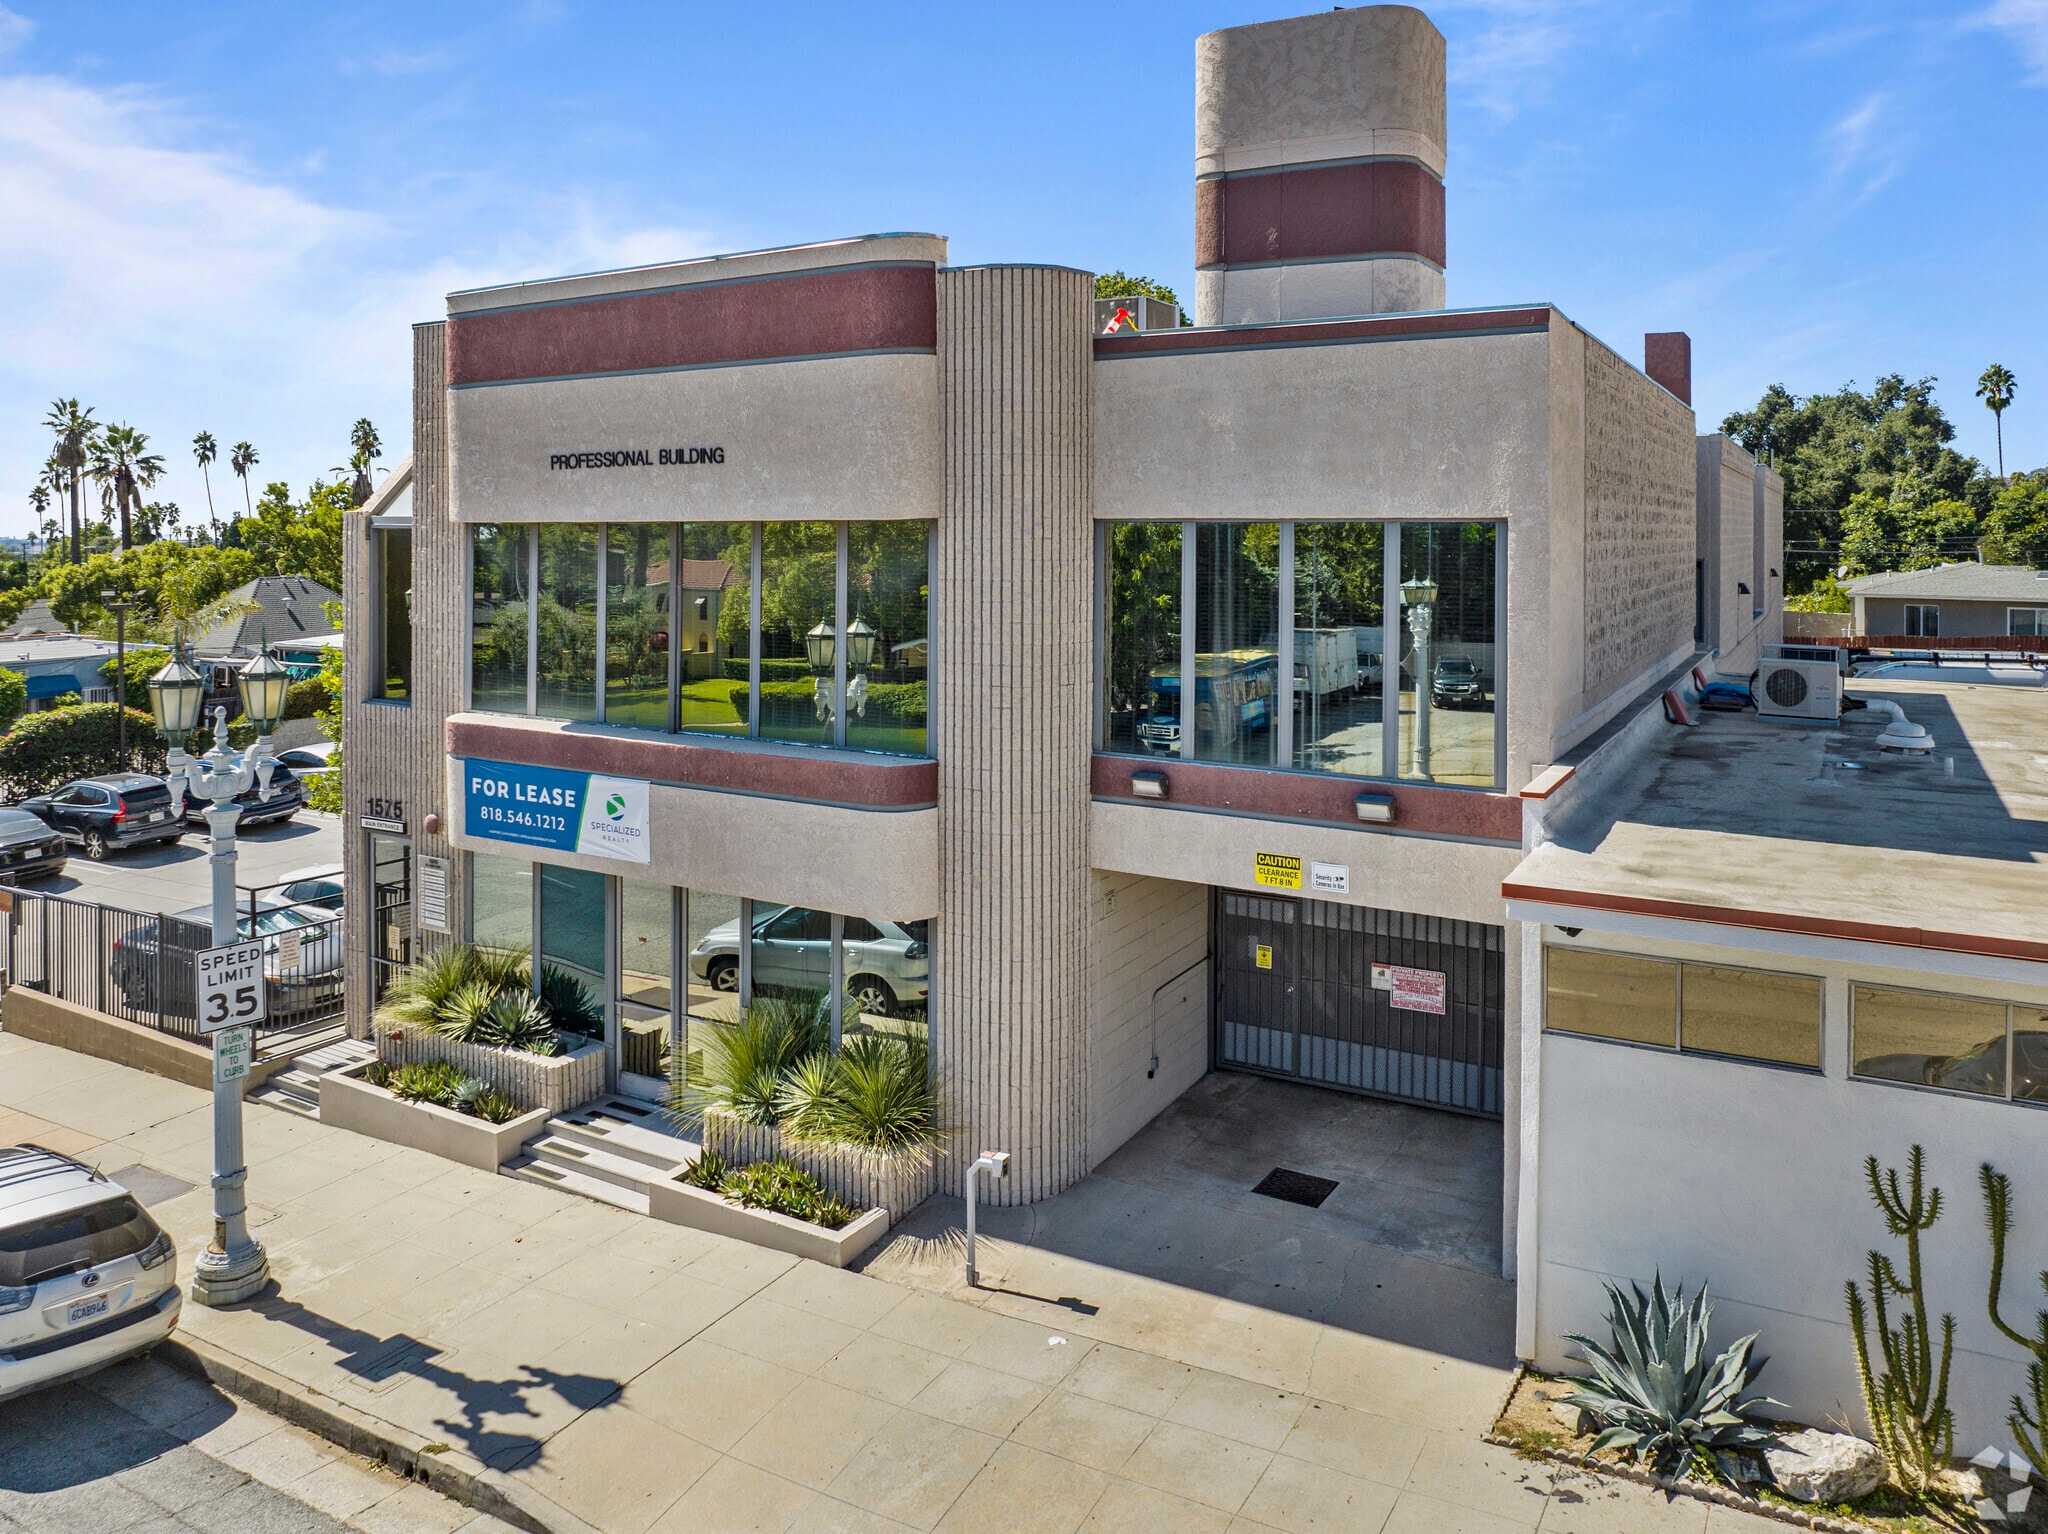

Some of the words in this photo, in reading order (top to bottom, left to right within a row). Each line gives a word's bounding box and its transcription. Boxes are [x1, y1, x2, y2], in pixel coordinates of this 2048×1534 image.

[550, 450, 654, 470] PROFESSIONAL
[659, 447, 725, 465] BUILDING
[471, 777, 510, 799] FOR
[515, 783, 577, 808] LEASE
[367, 797, 403, 818] 1575
[364, 820, 377, 828] MAIN
[377, 821, 400, 831] ENTRANCE
[480, 806, 566, 831] 818.546.1212
[591, 821, 641, 838] SPECIALIZED
[602, 834, 631, 844] REALTY
[1257, 854, 1300, 869] CAUTION
[1258, 867, 1299, 880] CLEARANCE
[1315, 873, 1332, 882] Security
[1270, 876, 1278, 884] FT
[1279, 878, 1284, 886] 8
[1285, 879, 1293, 887] IN
[1315, 880, 1332, 888] Cameras
[201, 948, 261, 971] SPEED
[207, 965, 254, 987] LIMIT
[1392, 967, 1414, 975] PRIVATE
[1415, 970, 1443, 978] PROPERTY
[206, 985, 258, 1023] 35
[223, 1033, 244, 1045] TURN
[219, 1042, 248, 1057] WHEELS
[229, 1055, 239, 1065] TO
[223, 1065, 245, 1078] CURB
